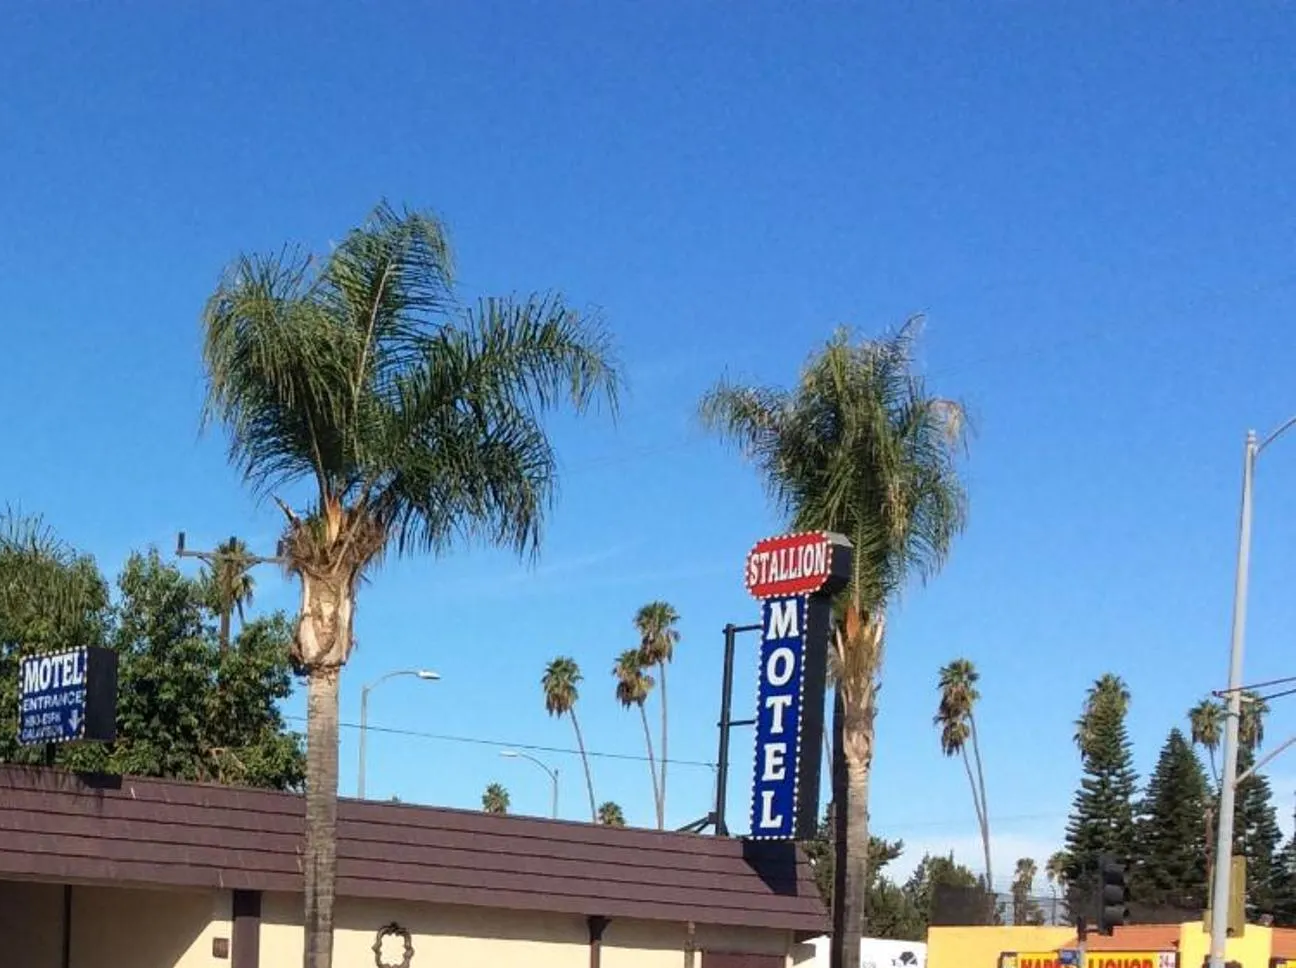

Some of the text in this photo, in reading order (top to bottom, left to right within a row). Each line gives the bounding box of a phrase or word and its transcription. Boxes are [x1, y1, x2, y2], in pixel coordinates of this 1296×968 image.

[749, 542, 827, 586] STALLION
[23, 652, 84, 694] MOTEL
[23, 690, 83, 712] ENTRANCE
[759, 599, 800, 829] MOTEL
